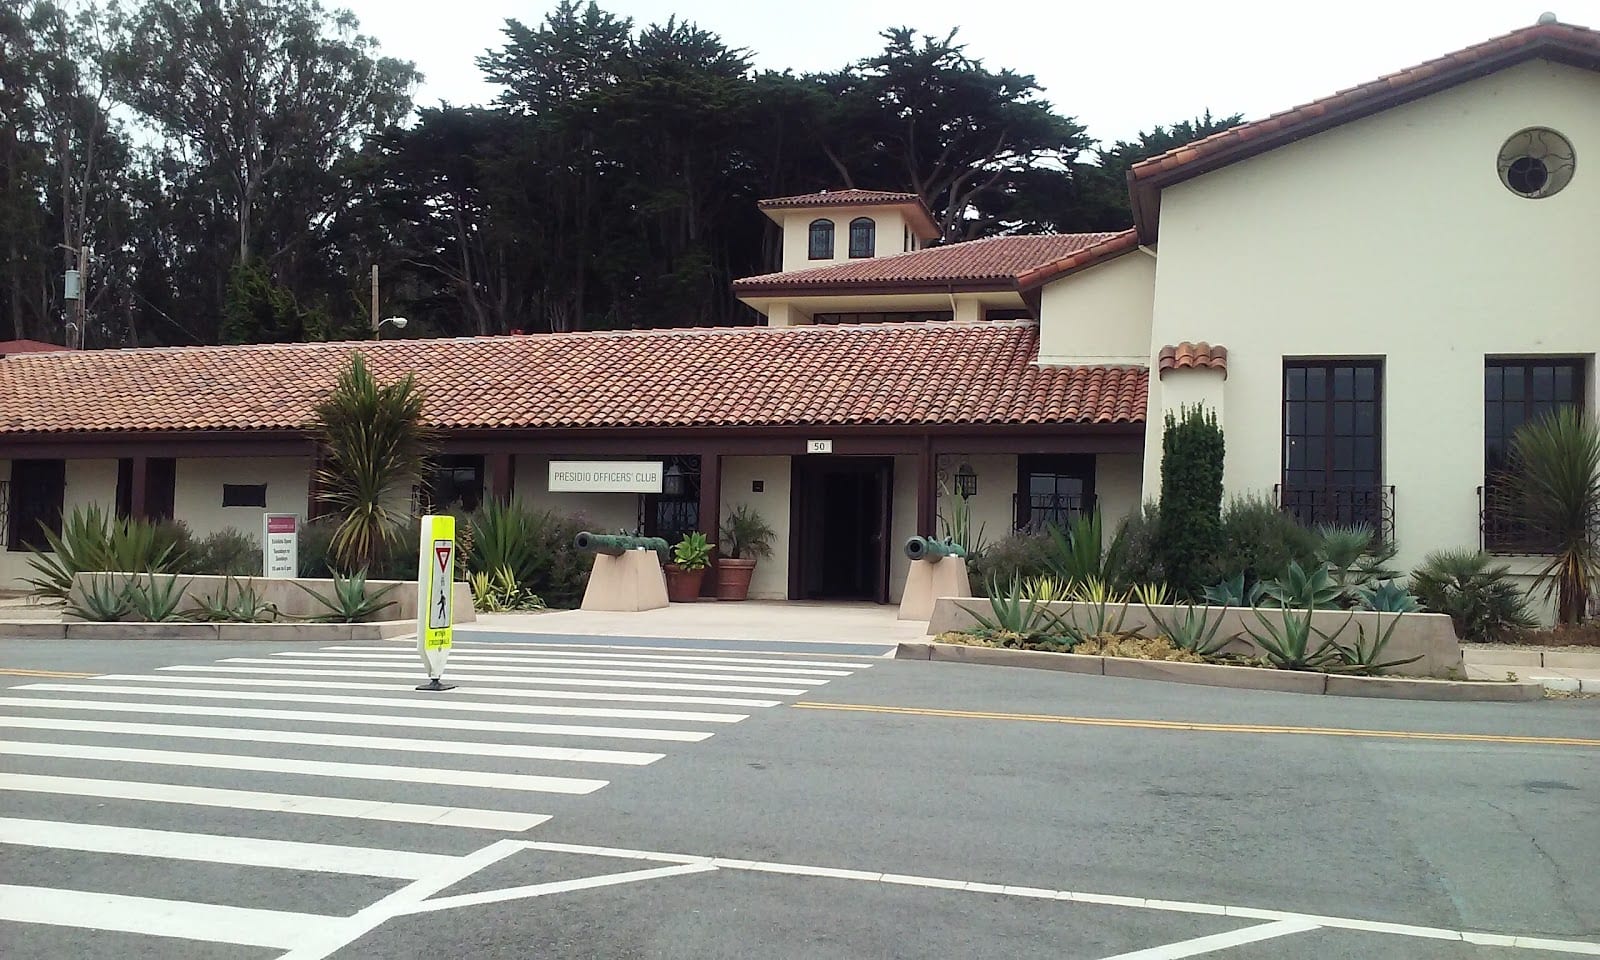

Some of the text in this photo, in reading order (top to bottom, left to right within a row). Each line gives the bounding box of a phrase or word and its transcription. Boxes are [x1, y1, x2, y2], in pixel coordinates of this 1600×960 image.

[814, 442, 825, 451] 50
[554, 471, 657, 482] PRESIDIO OFFICERS' CLUB
